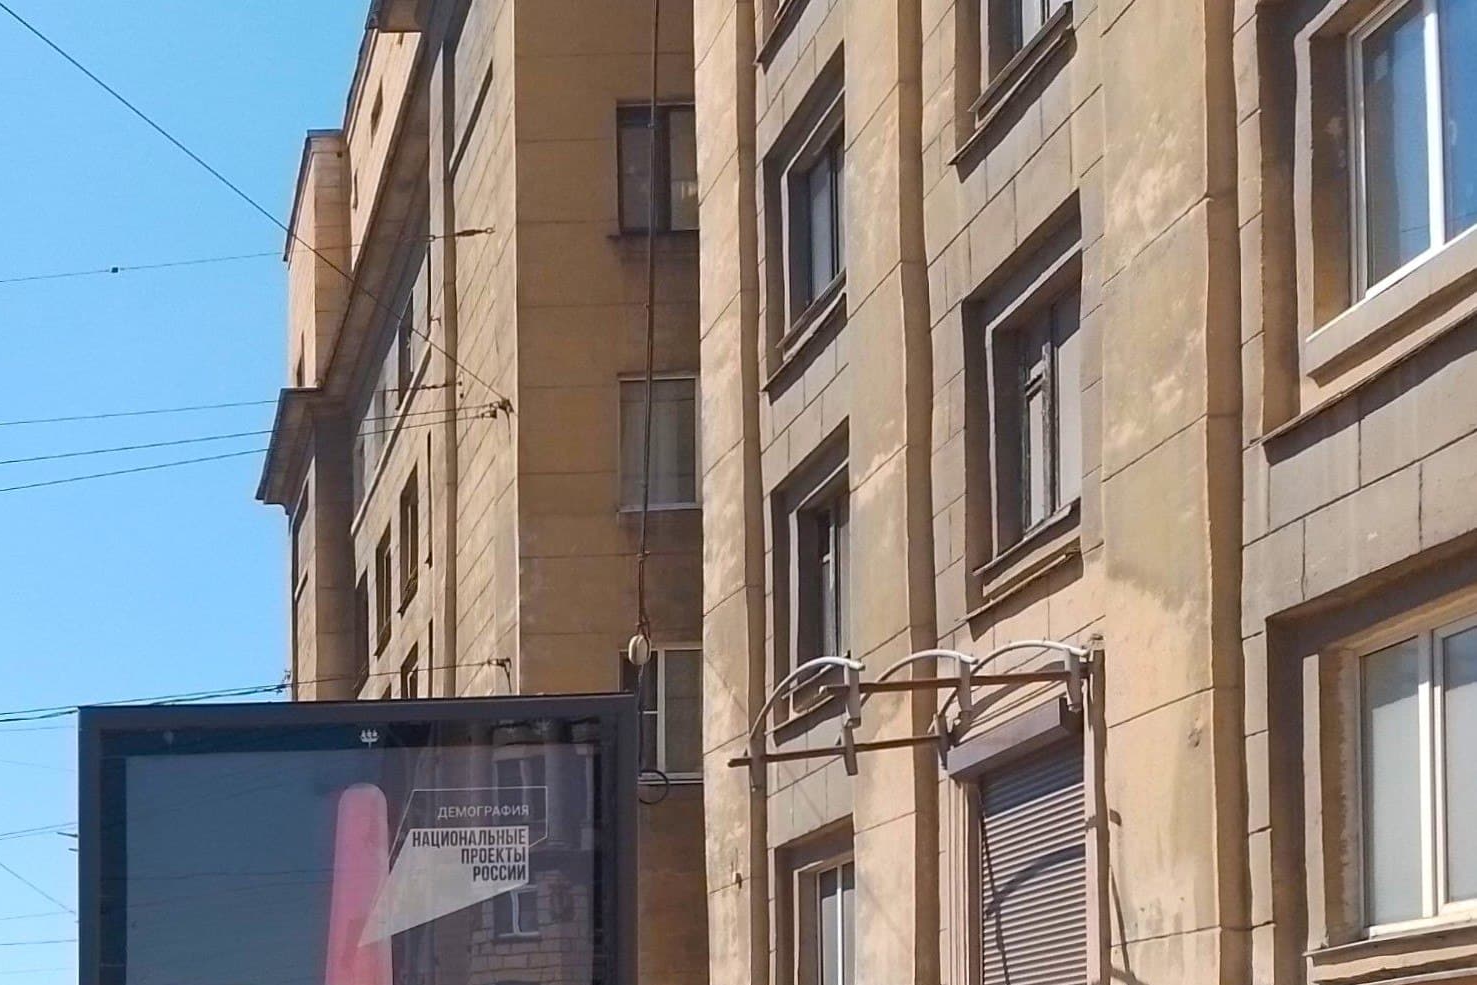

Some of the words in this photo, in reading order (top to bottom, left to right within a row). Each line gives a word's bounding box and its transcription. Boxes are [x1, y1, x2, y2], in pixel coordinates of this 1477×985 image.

[437, 804, 530, 820] ДЕМОГРАФИЯ
[412, 828, 527, 848] НАЦИОНАЛЬНЫЕ
[461, 846, 527, 864] ПРОЕКТЫ
[473, 864, 526, 882] РОССИИ
